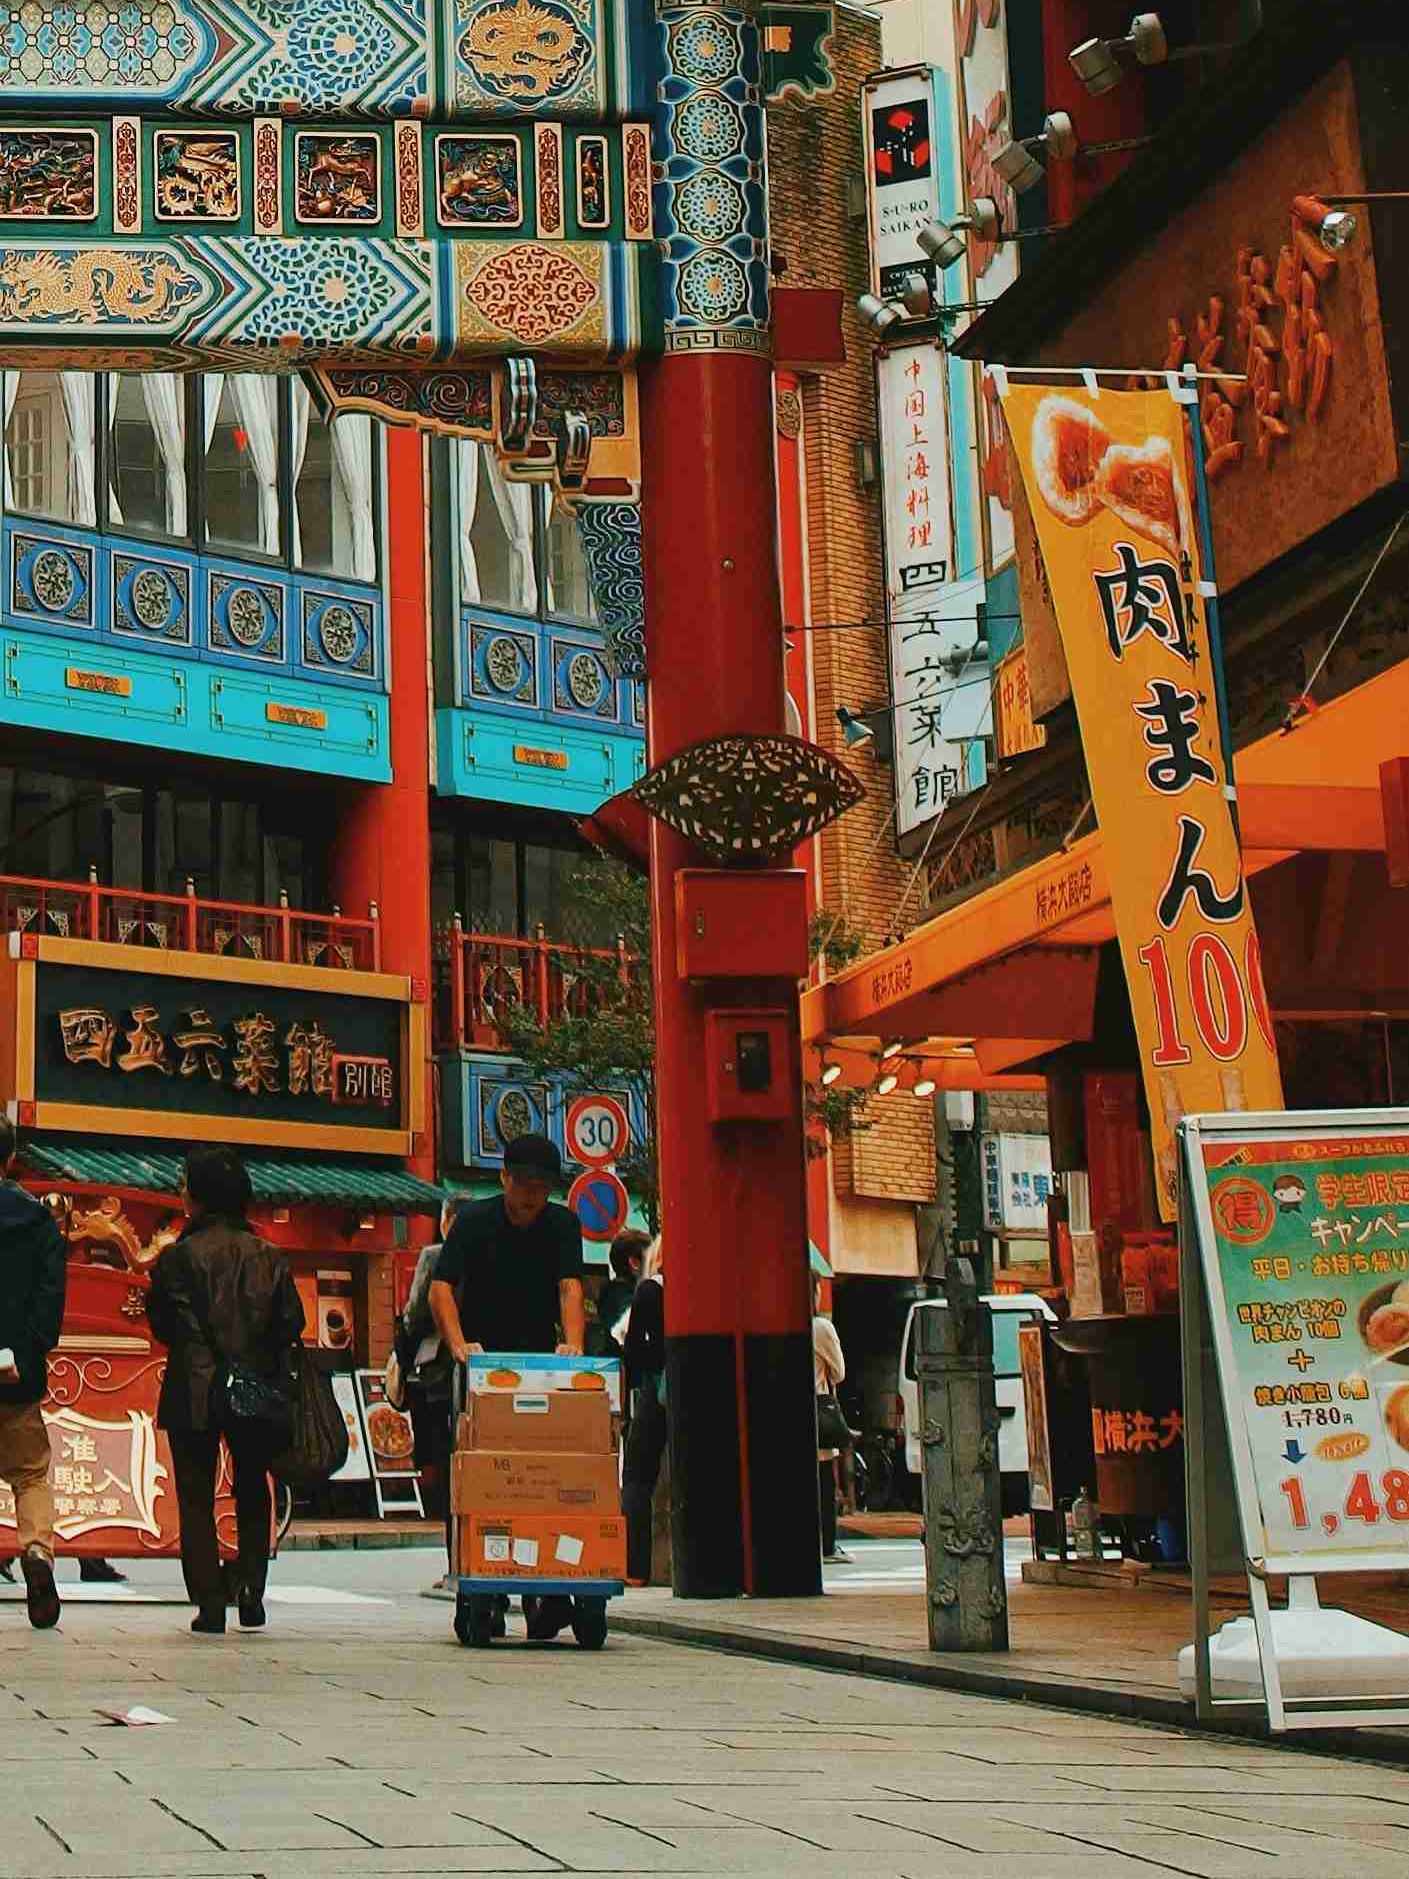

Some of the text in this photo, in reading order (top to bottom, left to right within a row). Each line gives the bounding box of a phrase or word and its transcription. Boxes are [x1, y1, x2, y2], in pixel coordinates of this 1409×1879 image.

[881, 198, 930, 219] S-U-RO
[902, 358, 934, 549] 中国上海料理
[899, 560, 961, 812] 四五六菜館
[1094, 542, 1244, 930] 肉まん
[581, 1116, 618, 1150] 30
[1237, 1298, 1348, 1324] 世界チャンピオンの
